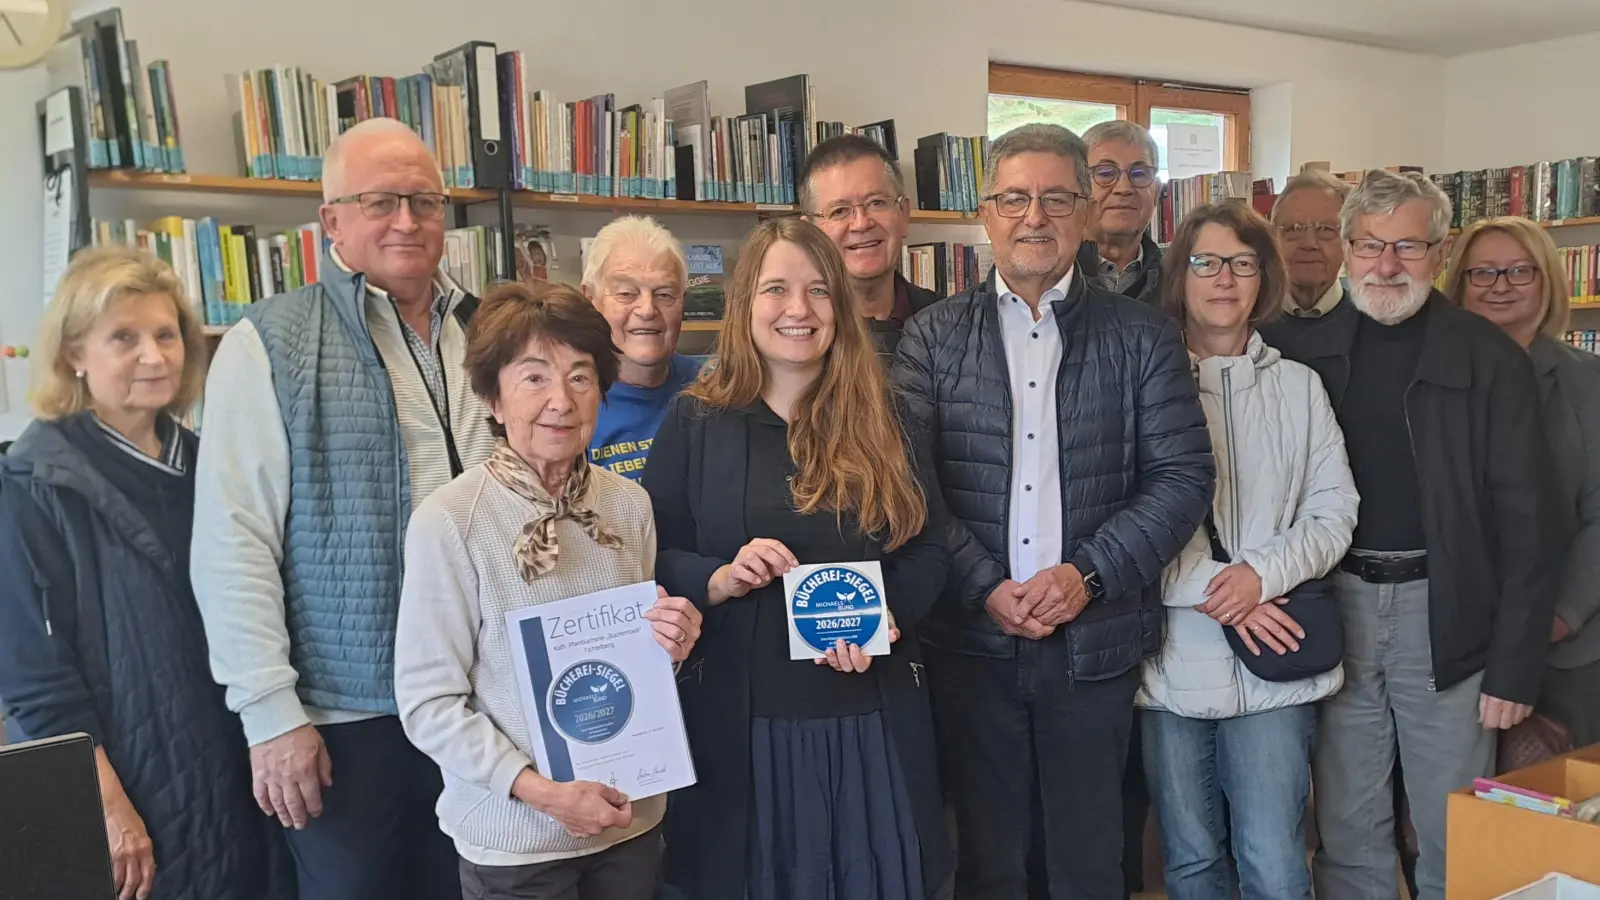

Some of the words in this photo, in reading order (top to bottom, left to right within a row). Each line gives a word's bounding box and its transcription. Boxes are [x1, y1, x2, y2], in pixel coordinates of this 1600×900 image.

[591, 441, 637, 460] DIENEN
[795, 569, 876, 608] BÜCHEREI-SIEGEL
[815, 600, 844, 608] MICHAELS
[547, 601, 647, 640] Zertifikat
[815, 617, 861, 630] 2026/2027
[554, 664, 626, 706] BÜCHEREI-SIEGEL
[572, 694, 598, 703] MICHAELS
[574, 706, 615, 723] 2026/2027
